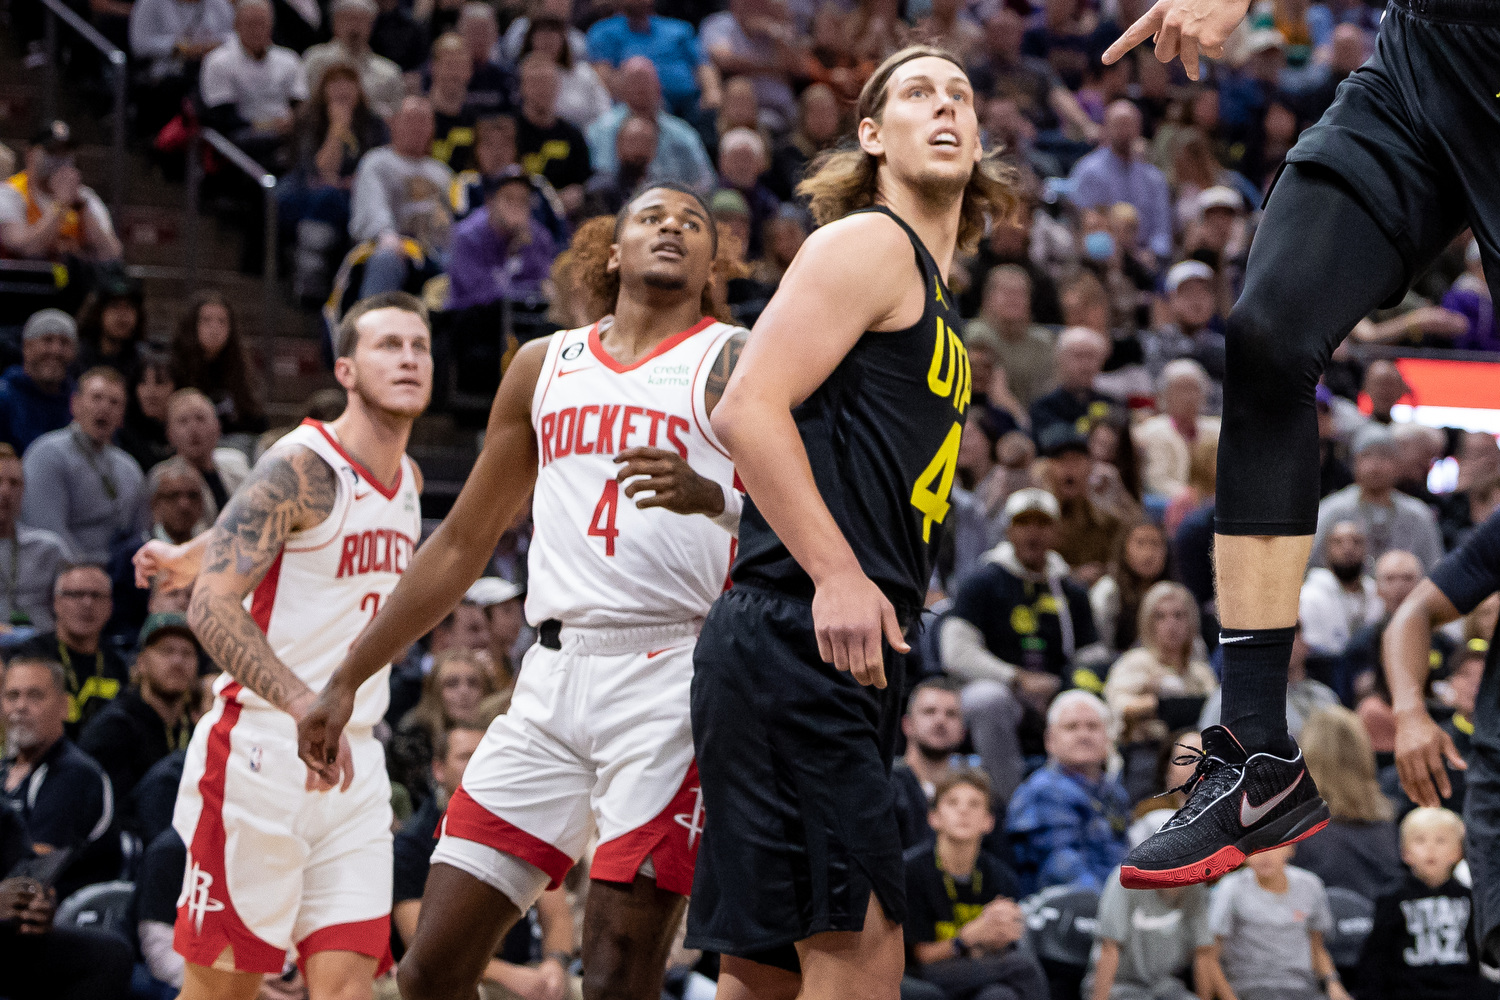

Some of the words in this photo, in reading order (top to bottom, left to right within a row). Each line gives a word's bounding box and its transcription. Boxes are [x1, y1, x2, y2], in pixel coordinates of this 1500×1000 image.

[541, 404, 690, 468] ROCKETS
[587, 479, 619, 557] 4
[910, 421, 962, 544] 4
